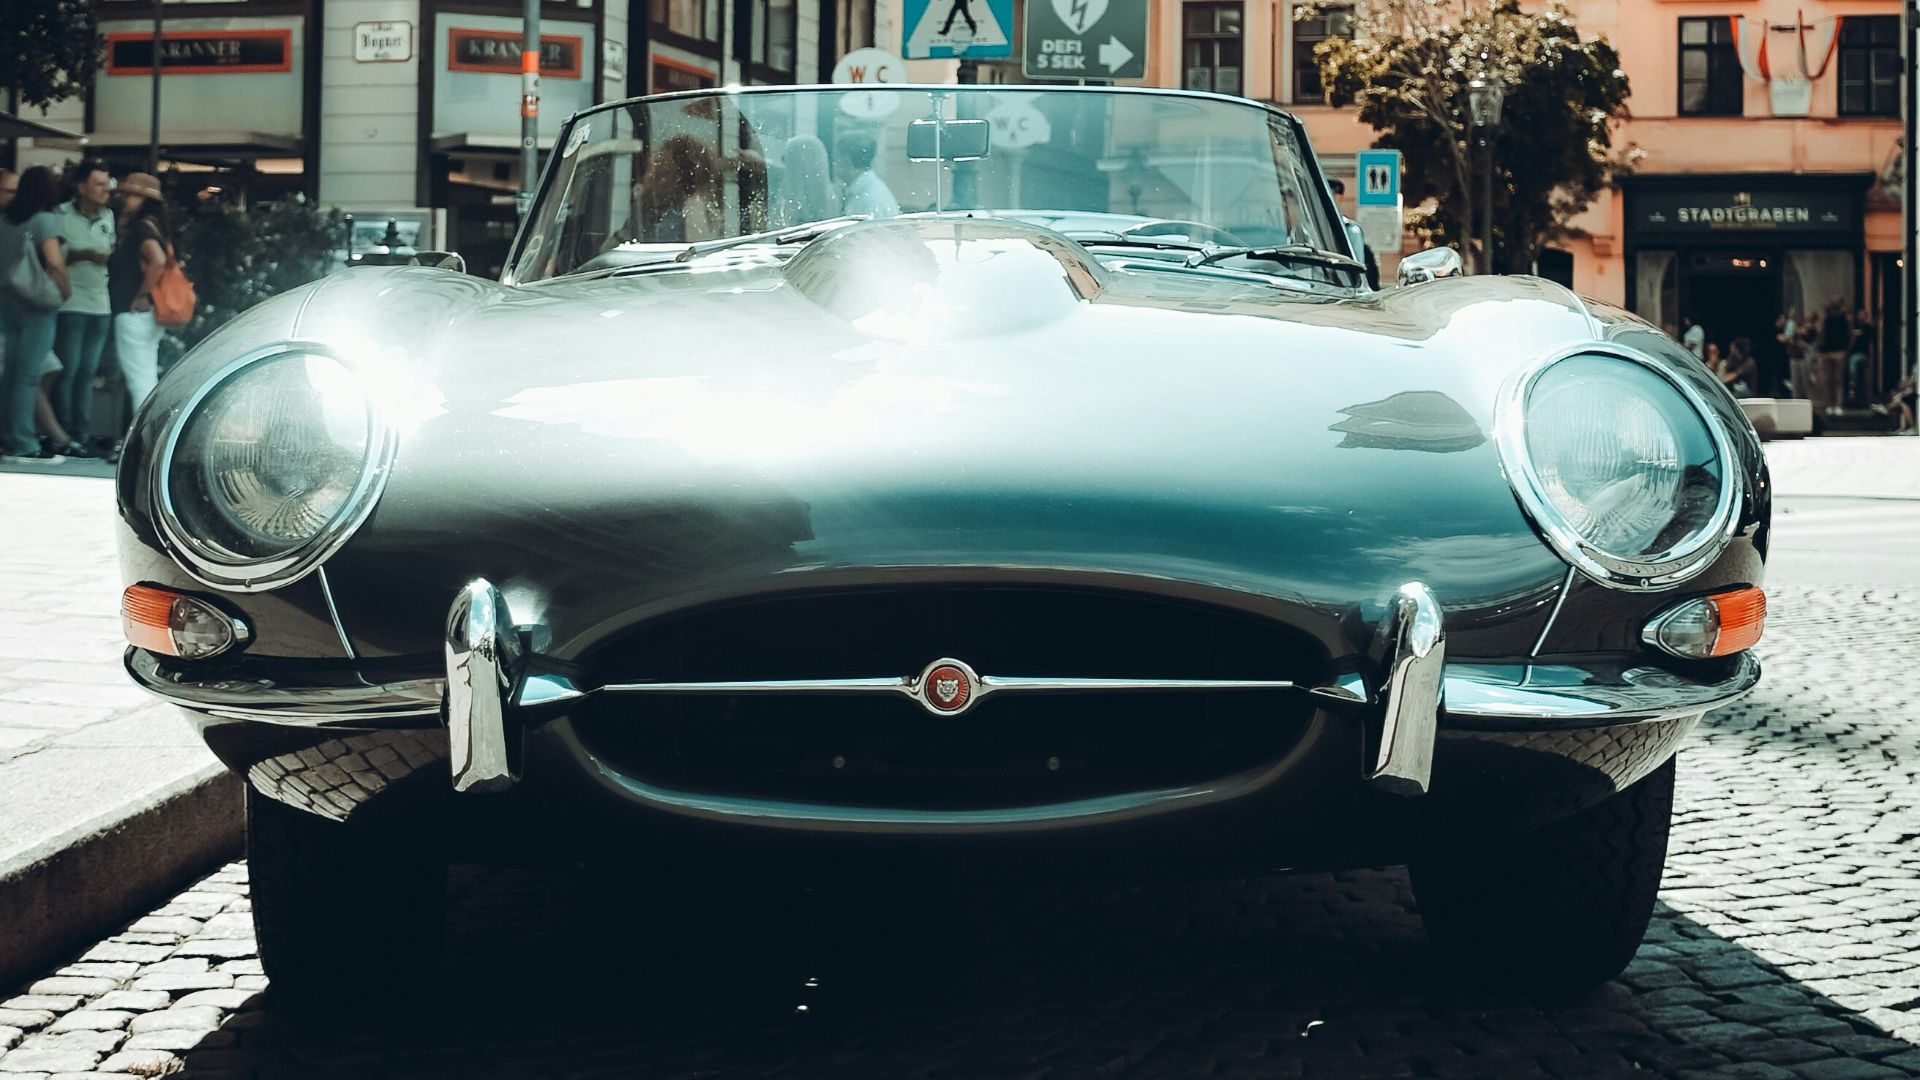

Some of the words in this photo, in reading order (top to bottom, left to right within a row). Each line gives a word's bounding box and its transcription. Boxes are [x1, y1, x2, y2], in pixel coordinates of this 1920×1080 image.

[1041, 39, 1082, 54] DEFI
[1037, 54, 1048, 69] 5
[1051, 54, 1086, 69] SEK
[1677, 207, 1809, 223] STADTGRABEN
